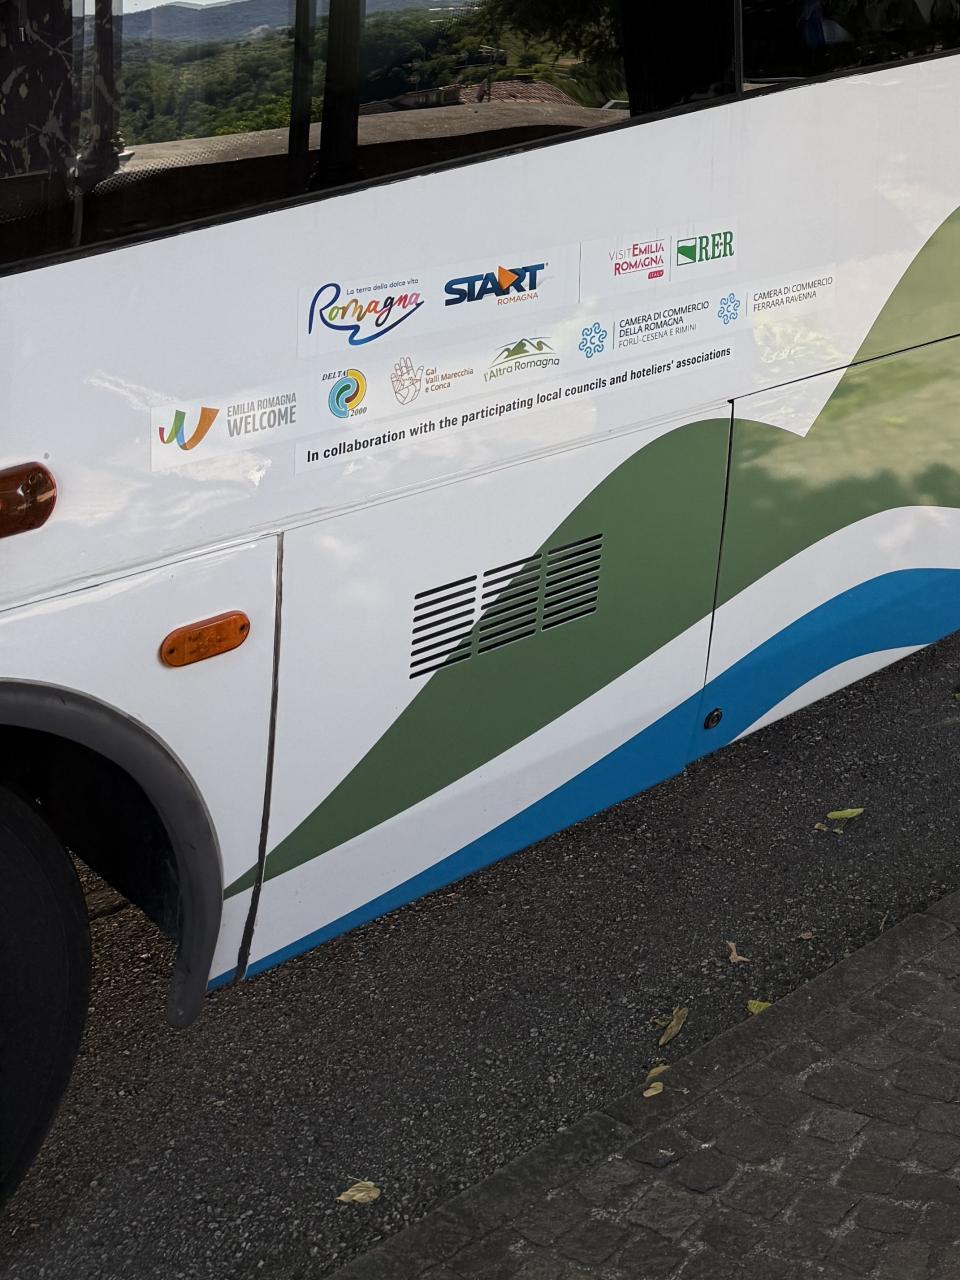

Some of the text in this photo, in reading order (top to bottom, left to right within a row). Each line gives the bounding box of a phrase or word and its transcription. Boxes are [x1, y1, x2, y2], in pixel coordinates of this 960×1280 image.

[608, 243, 664, 260] VISIT EMILIA
[614, 256, 664, 276] ROMAGNA
[444, 263, 544, 306] START
[753, 288, 782, 301] CAMERA
[792, 277, 833, 292] COMMERCIO
[497, 292, 538, 305] ROMAGNA
[753, 291, 816, 312] FERRARA RAVENNA
[309, 283, 424, 345] Romagna
[620, 301, 709, 328] CAMERA DI COMMERCIO
[620, 316, 683, 337] DELLA ROMAGNA
[676, 324, 696, 334] RIMINI
[426, 368, 436, 376] Gal
[515, 358, 560, 371] Romagna
[322, 370, 346, 381] DELTA
[426, 368, 473, 384] Valli Marecchia
[431, 383, 450, 391] Conca
[227, 393, 296, 417] EMILIA ROMAGNA
[307, 450, 319, 462] In
[324, 430, 405, 458] collaboration
[410, 421, 435, 436] with
[439, 417, 457, 429] the
[462, 396, 533, 424] participating
[537, 387, 562, 404] local
[565, 377, 606, 396] councils
[610, 371, 627, 385] and
[676, 347, 730, 368] associations
[350, 407, 367, 417] 2000
[227, 405, 296, 437] WELCOME
